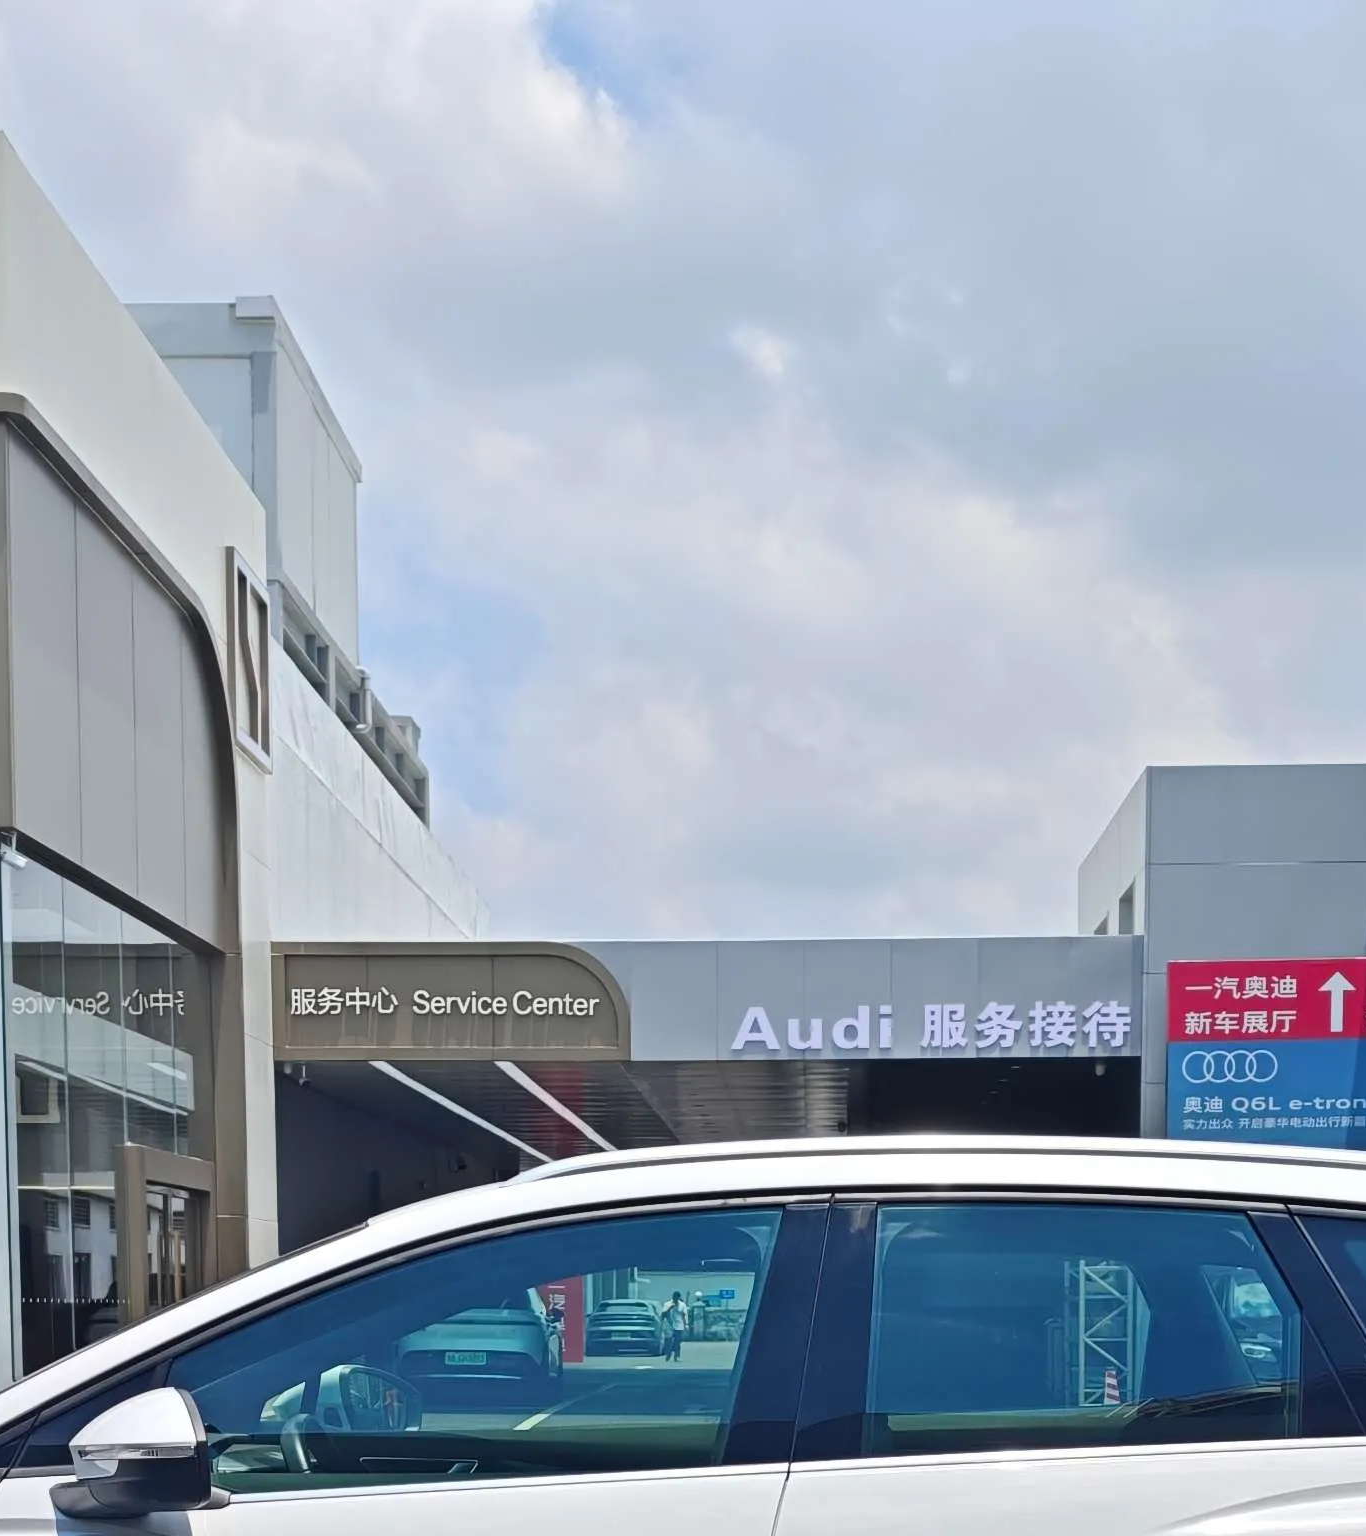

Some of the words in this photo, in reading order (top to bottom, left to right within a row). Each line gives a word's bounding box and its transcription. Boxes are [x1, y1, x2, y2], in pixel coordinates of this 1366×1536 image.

[1185, 975, 1297, 1000] 一汽奥迪
[290, 986, 399, 1015] 服务中心
[412, 989, 508, 1015] Service
[511, 990, 600, 1016] Center
[731, 1005, 892, 1051] Audi
[919, 1001, 1132, 1048] 服务接待
[1184, 1010, 1297, 1035] 新车展厅
[1182, 1096, 1224, 1113] 奥迪
[1231, 1096, 1282, 1114] Q6L
[1289, 1096, 1366, 1110] e-tron
